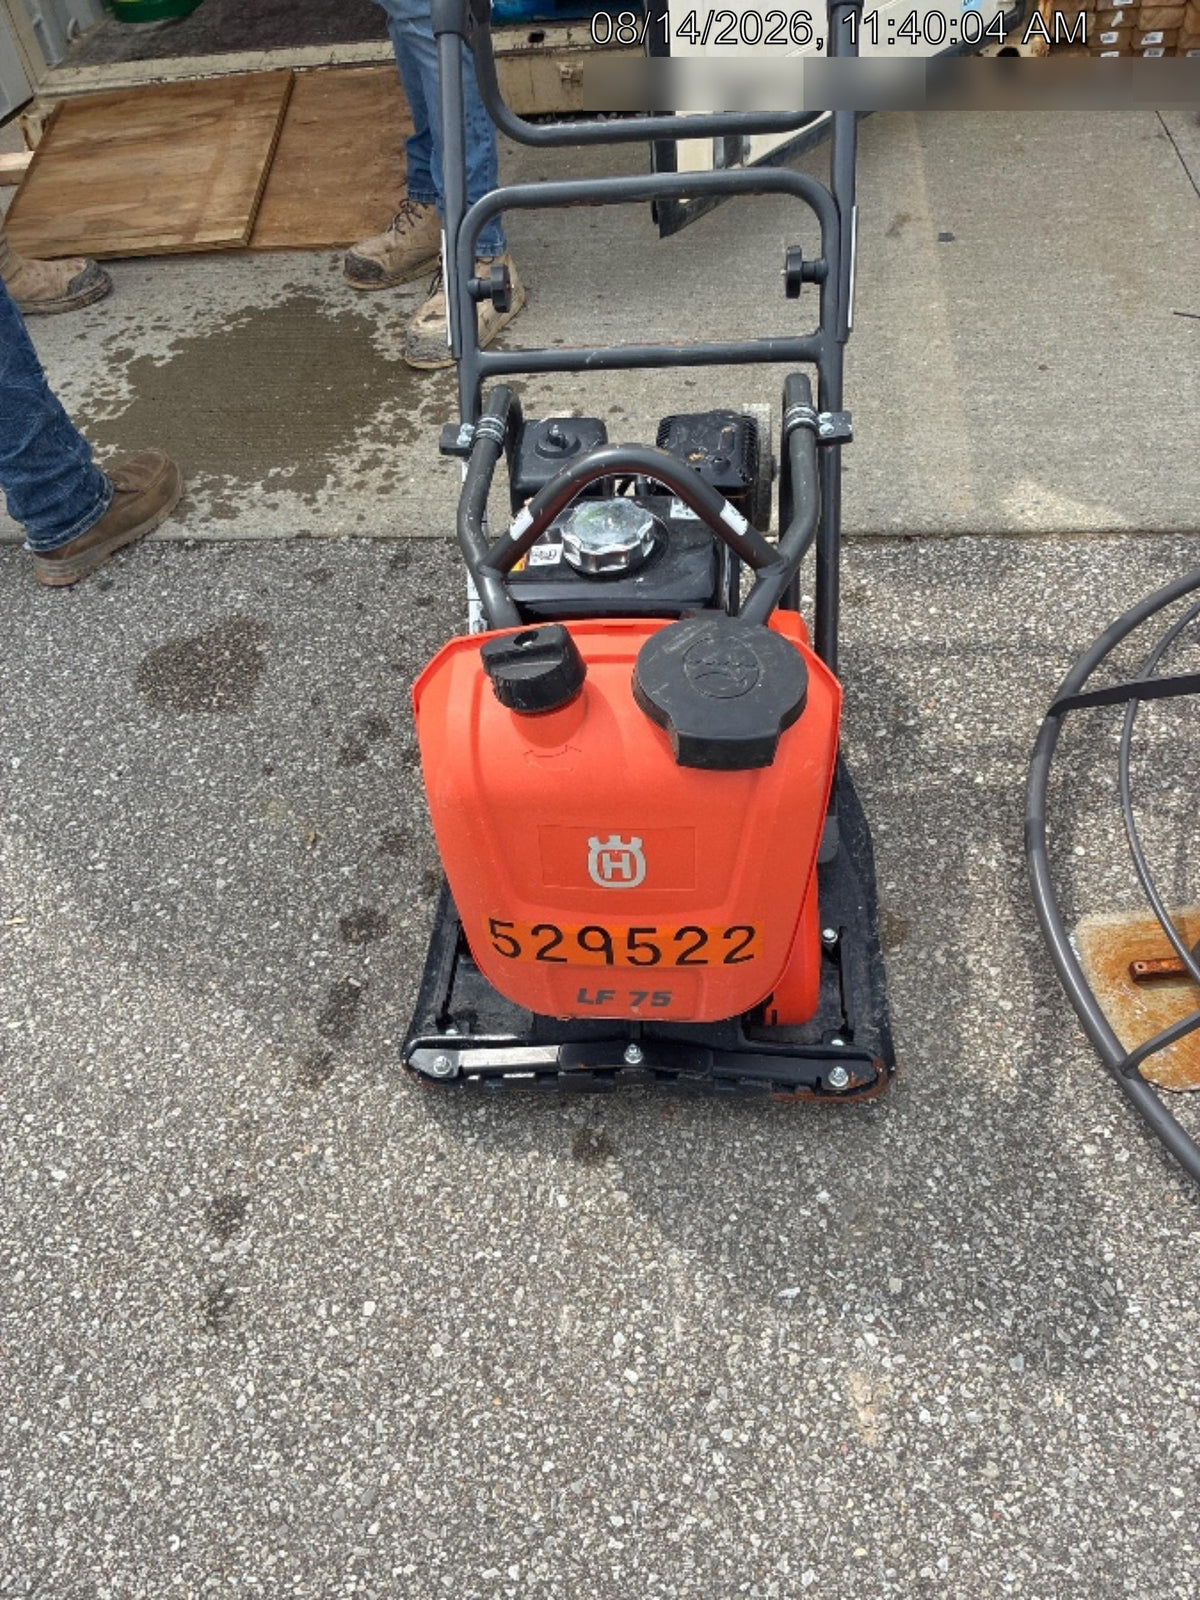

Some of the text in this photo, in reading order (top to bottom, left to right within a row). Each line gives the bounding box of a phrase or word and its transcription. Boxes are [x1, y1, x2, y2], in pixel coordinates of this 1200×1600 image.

[488, 917, 757, 966] 529522
[577, 988, 673, 1008] LF 75
